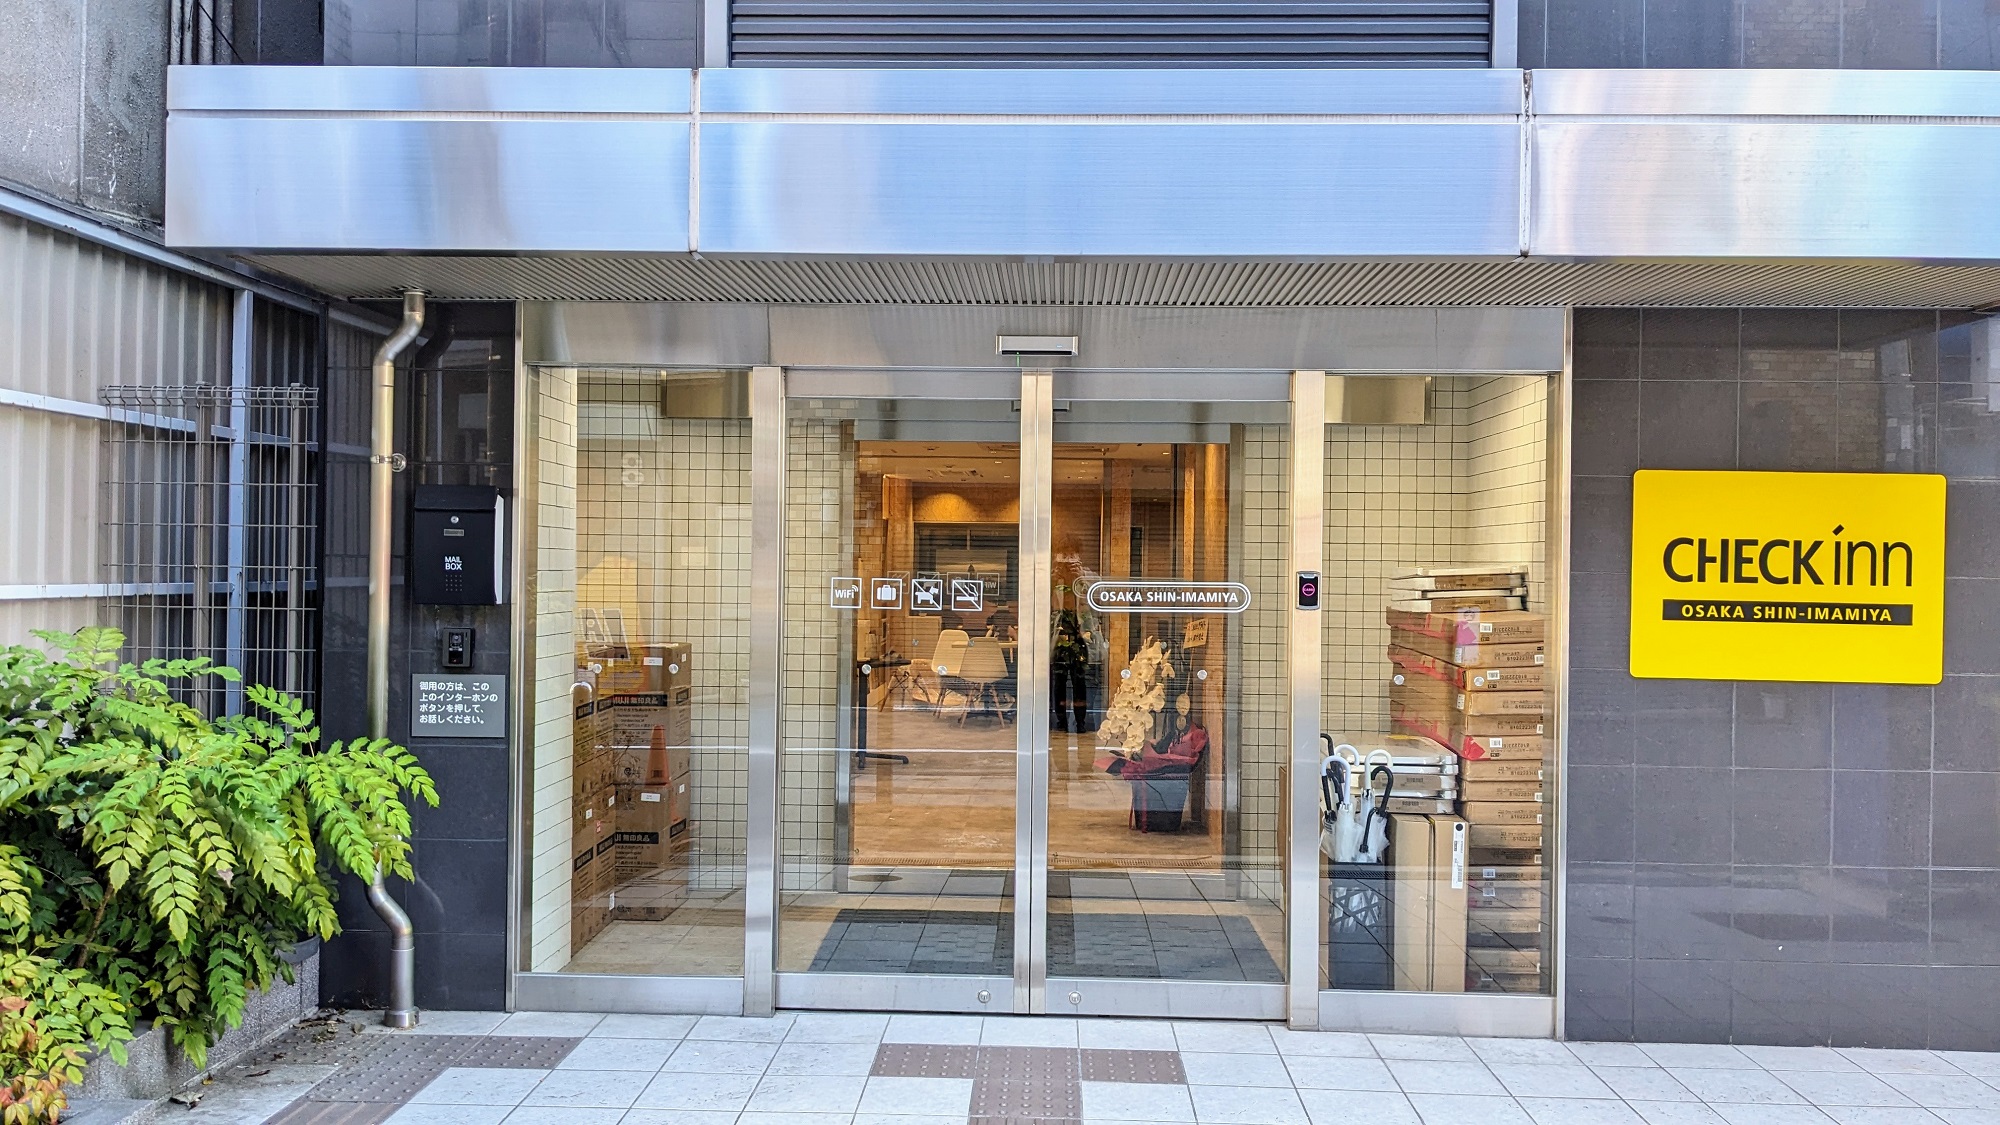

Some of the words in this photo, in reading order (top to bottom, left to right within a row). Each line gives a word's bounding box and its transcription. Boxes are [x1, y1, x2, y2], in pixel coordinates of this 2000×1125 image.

[444, 555, 463, 564] MAIL
[1662, 537, 1825, 585] CHECK
[445, 562, 463, 571] BOX
[835, 588, 855, 599] WiFi
[1100, 591, 1143, 602] OSAKA
[1146, 591, 1238, 603] SHIN-IMAMIYA
[1681, 604, 1745, 619] OSAKA
[1753, 605, 1892, 621] SHIN-IMAMIYA
[419, 681, 490, 691] 御用の方は、この
[419, 692, 498, 702] 上のインターホンの
[419, 703, 484, 713] ボタンを押して、
[419, 714, 484, 724] お話しください。
